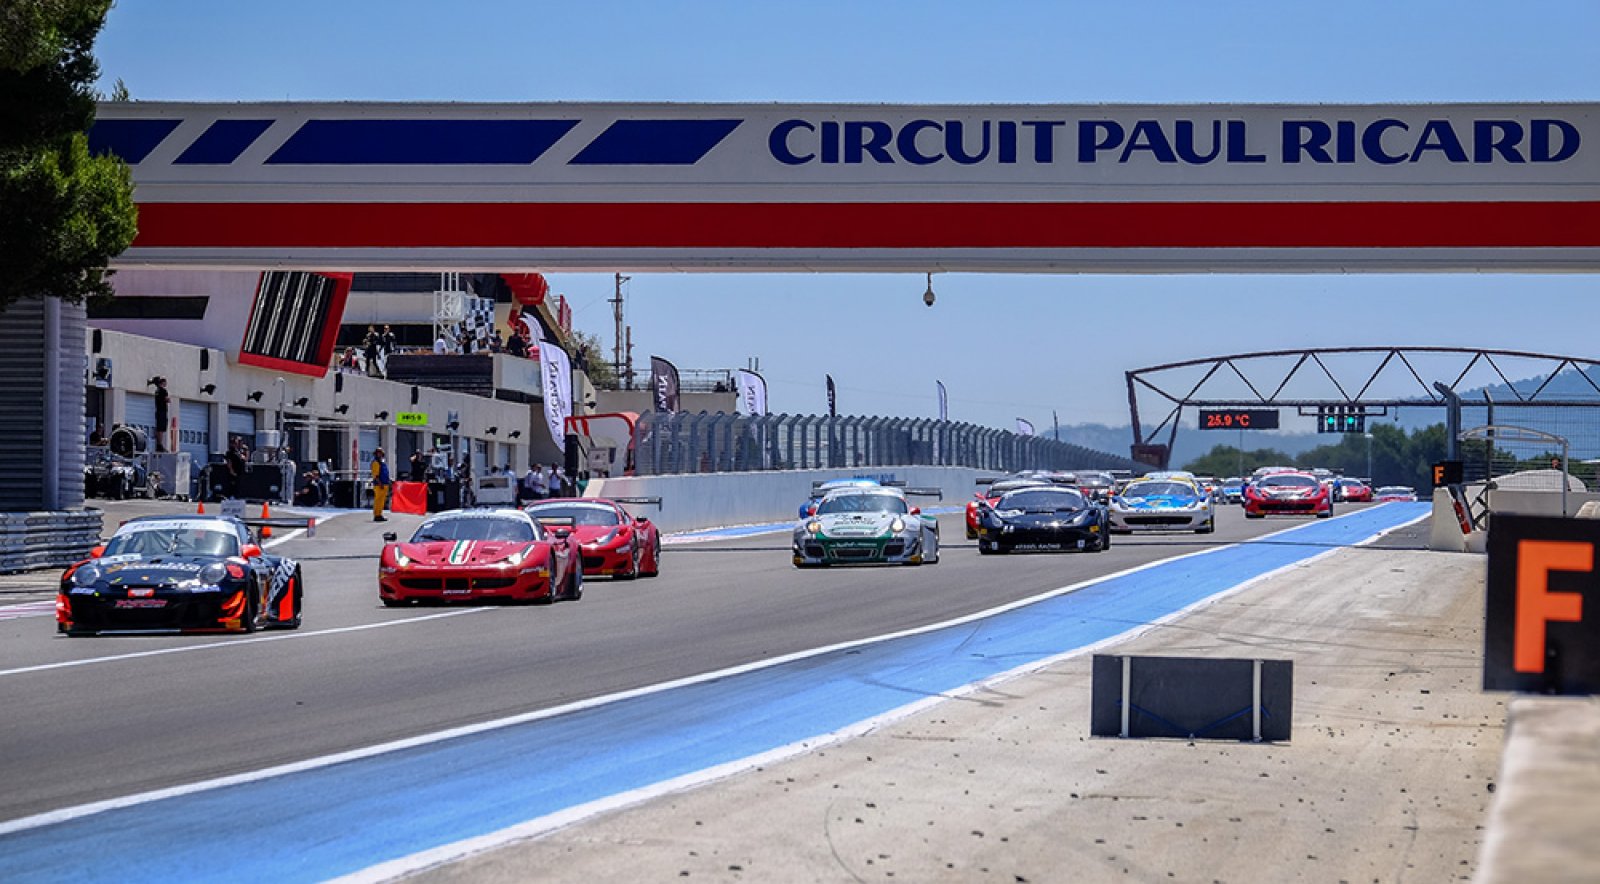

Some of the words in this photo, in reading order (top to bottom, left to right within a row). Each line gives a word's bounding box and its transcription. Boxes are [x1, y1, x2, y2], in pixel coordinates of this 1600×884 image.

[768, 119, 1066, 165] CIRCUIT
[1078, 119, 1267, 165] PAUL
[1281, 119, 1581, 165] RICARD
[1207, 414, 1232, 426] 25.9
[1235, 414, 1250, 427] °C
[1434, 466, 1445, 484] F
[1514, 540, 1594, 673] F
